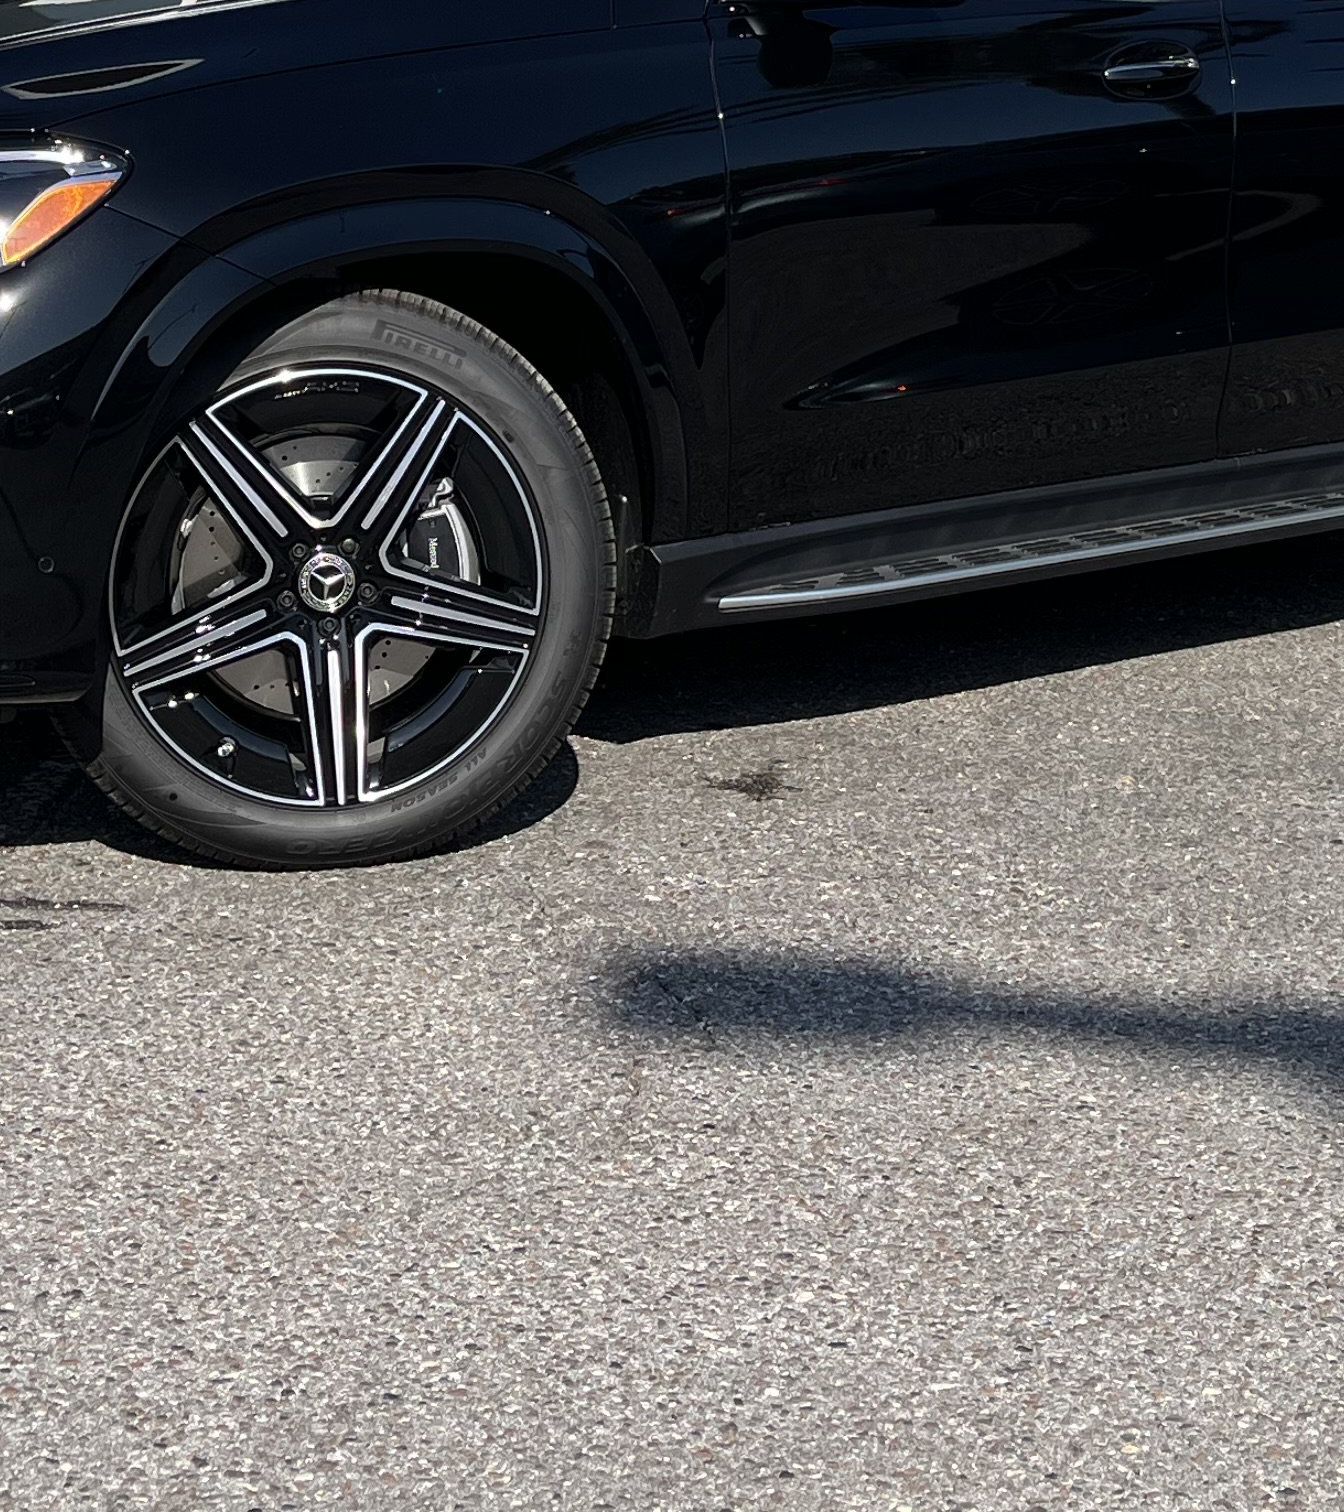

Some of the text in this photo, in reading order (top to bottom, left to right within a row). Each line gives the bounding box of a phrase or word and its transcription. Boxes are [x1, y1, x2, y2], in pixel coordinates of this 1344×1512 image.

[369, 317, 468, 370] PIRELLI
[391, 746, 488, 813] ALL SEASON
